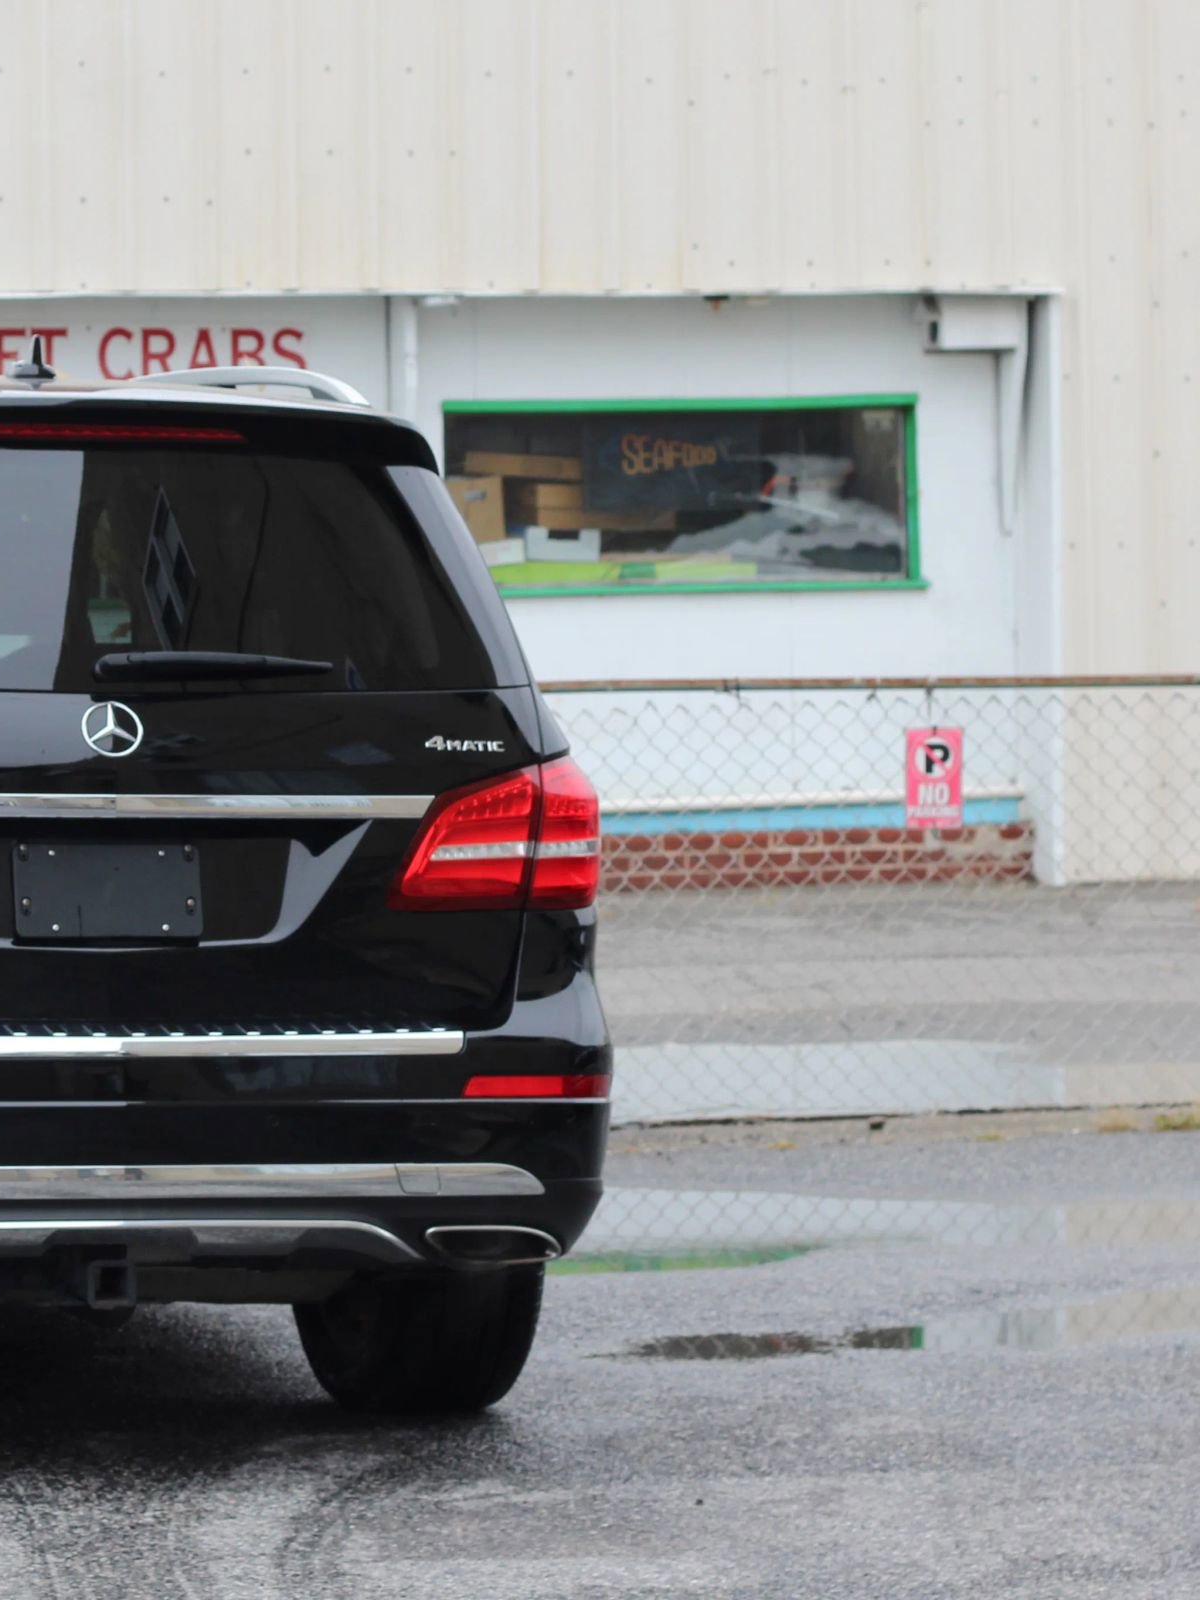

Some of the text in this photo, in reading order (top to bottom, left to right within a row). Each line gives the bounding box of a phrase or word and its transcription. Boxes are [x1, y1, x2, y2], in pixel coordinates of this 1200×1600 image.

[97, 326, 308, 381] CRABS
[425, 735, 505, 752] 4MATIC
[918, 782, 950, 806] NO
